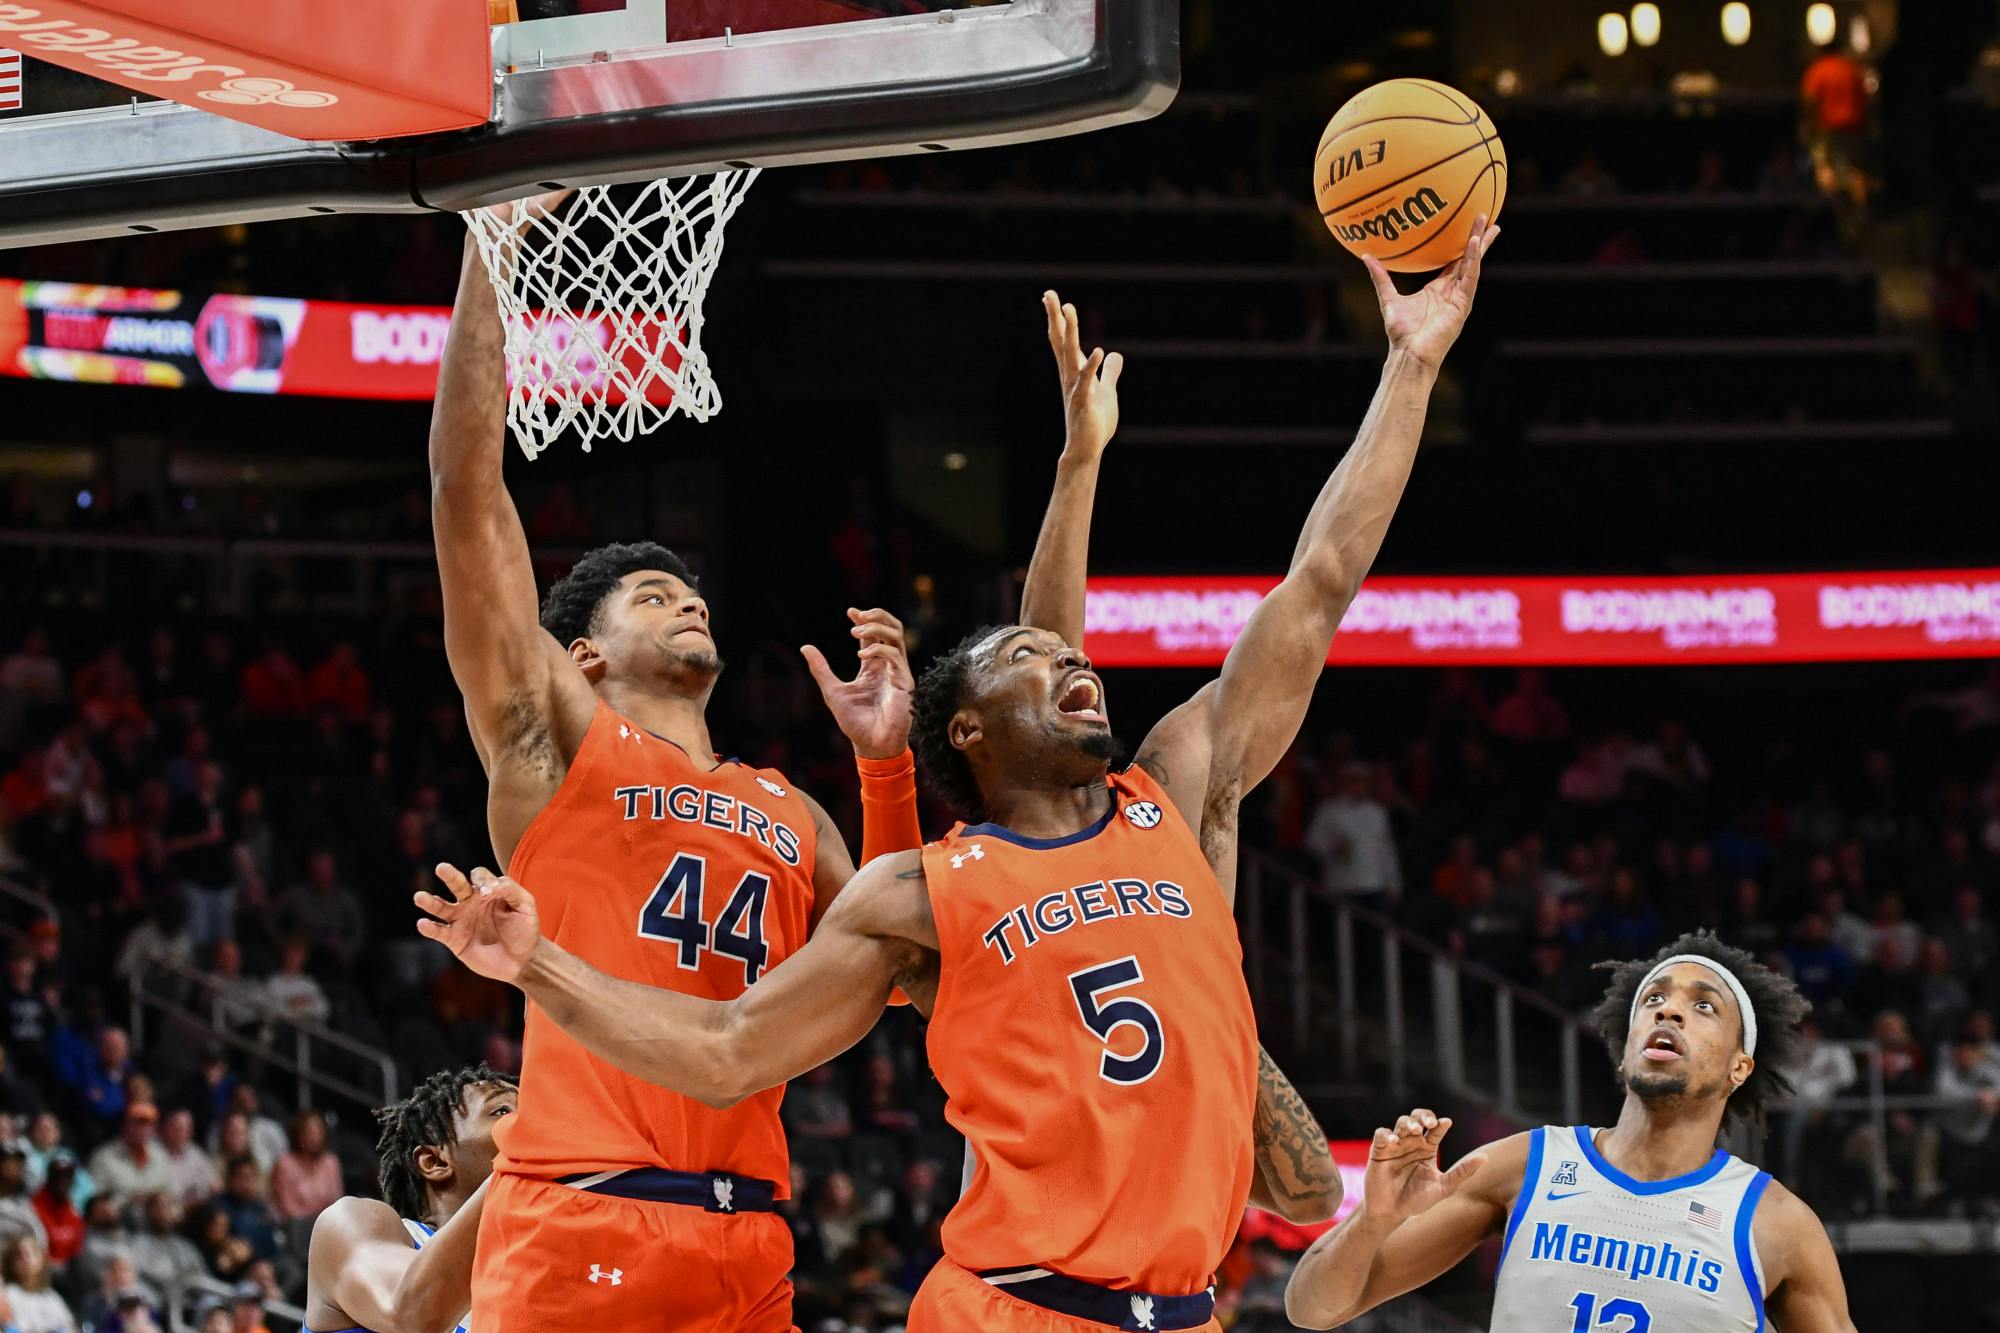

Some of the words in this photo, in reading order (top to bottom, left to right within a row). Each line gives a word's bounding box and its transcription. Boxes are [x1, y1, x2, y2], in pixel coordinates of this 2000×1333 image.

[1328, 139, 1386, 187] EVO
[1333, 187, 1449, 242] Wilson
[1560, 588, 1776, 633] BODYARMOR
[1818, 580, 2000, 629] BODYARMO
[614, 784, 799, 866] TIGERS
[1124, 801, 1162, 829] SEC
[637, 851, 771, 987] 44
[982, 878, 1192, 966] TIGERS
[1067, 955, 1165, 1086] 5
[1529, 1221, 1726, 1295] Memphis
